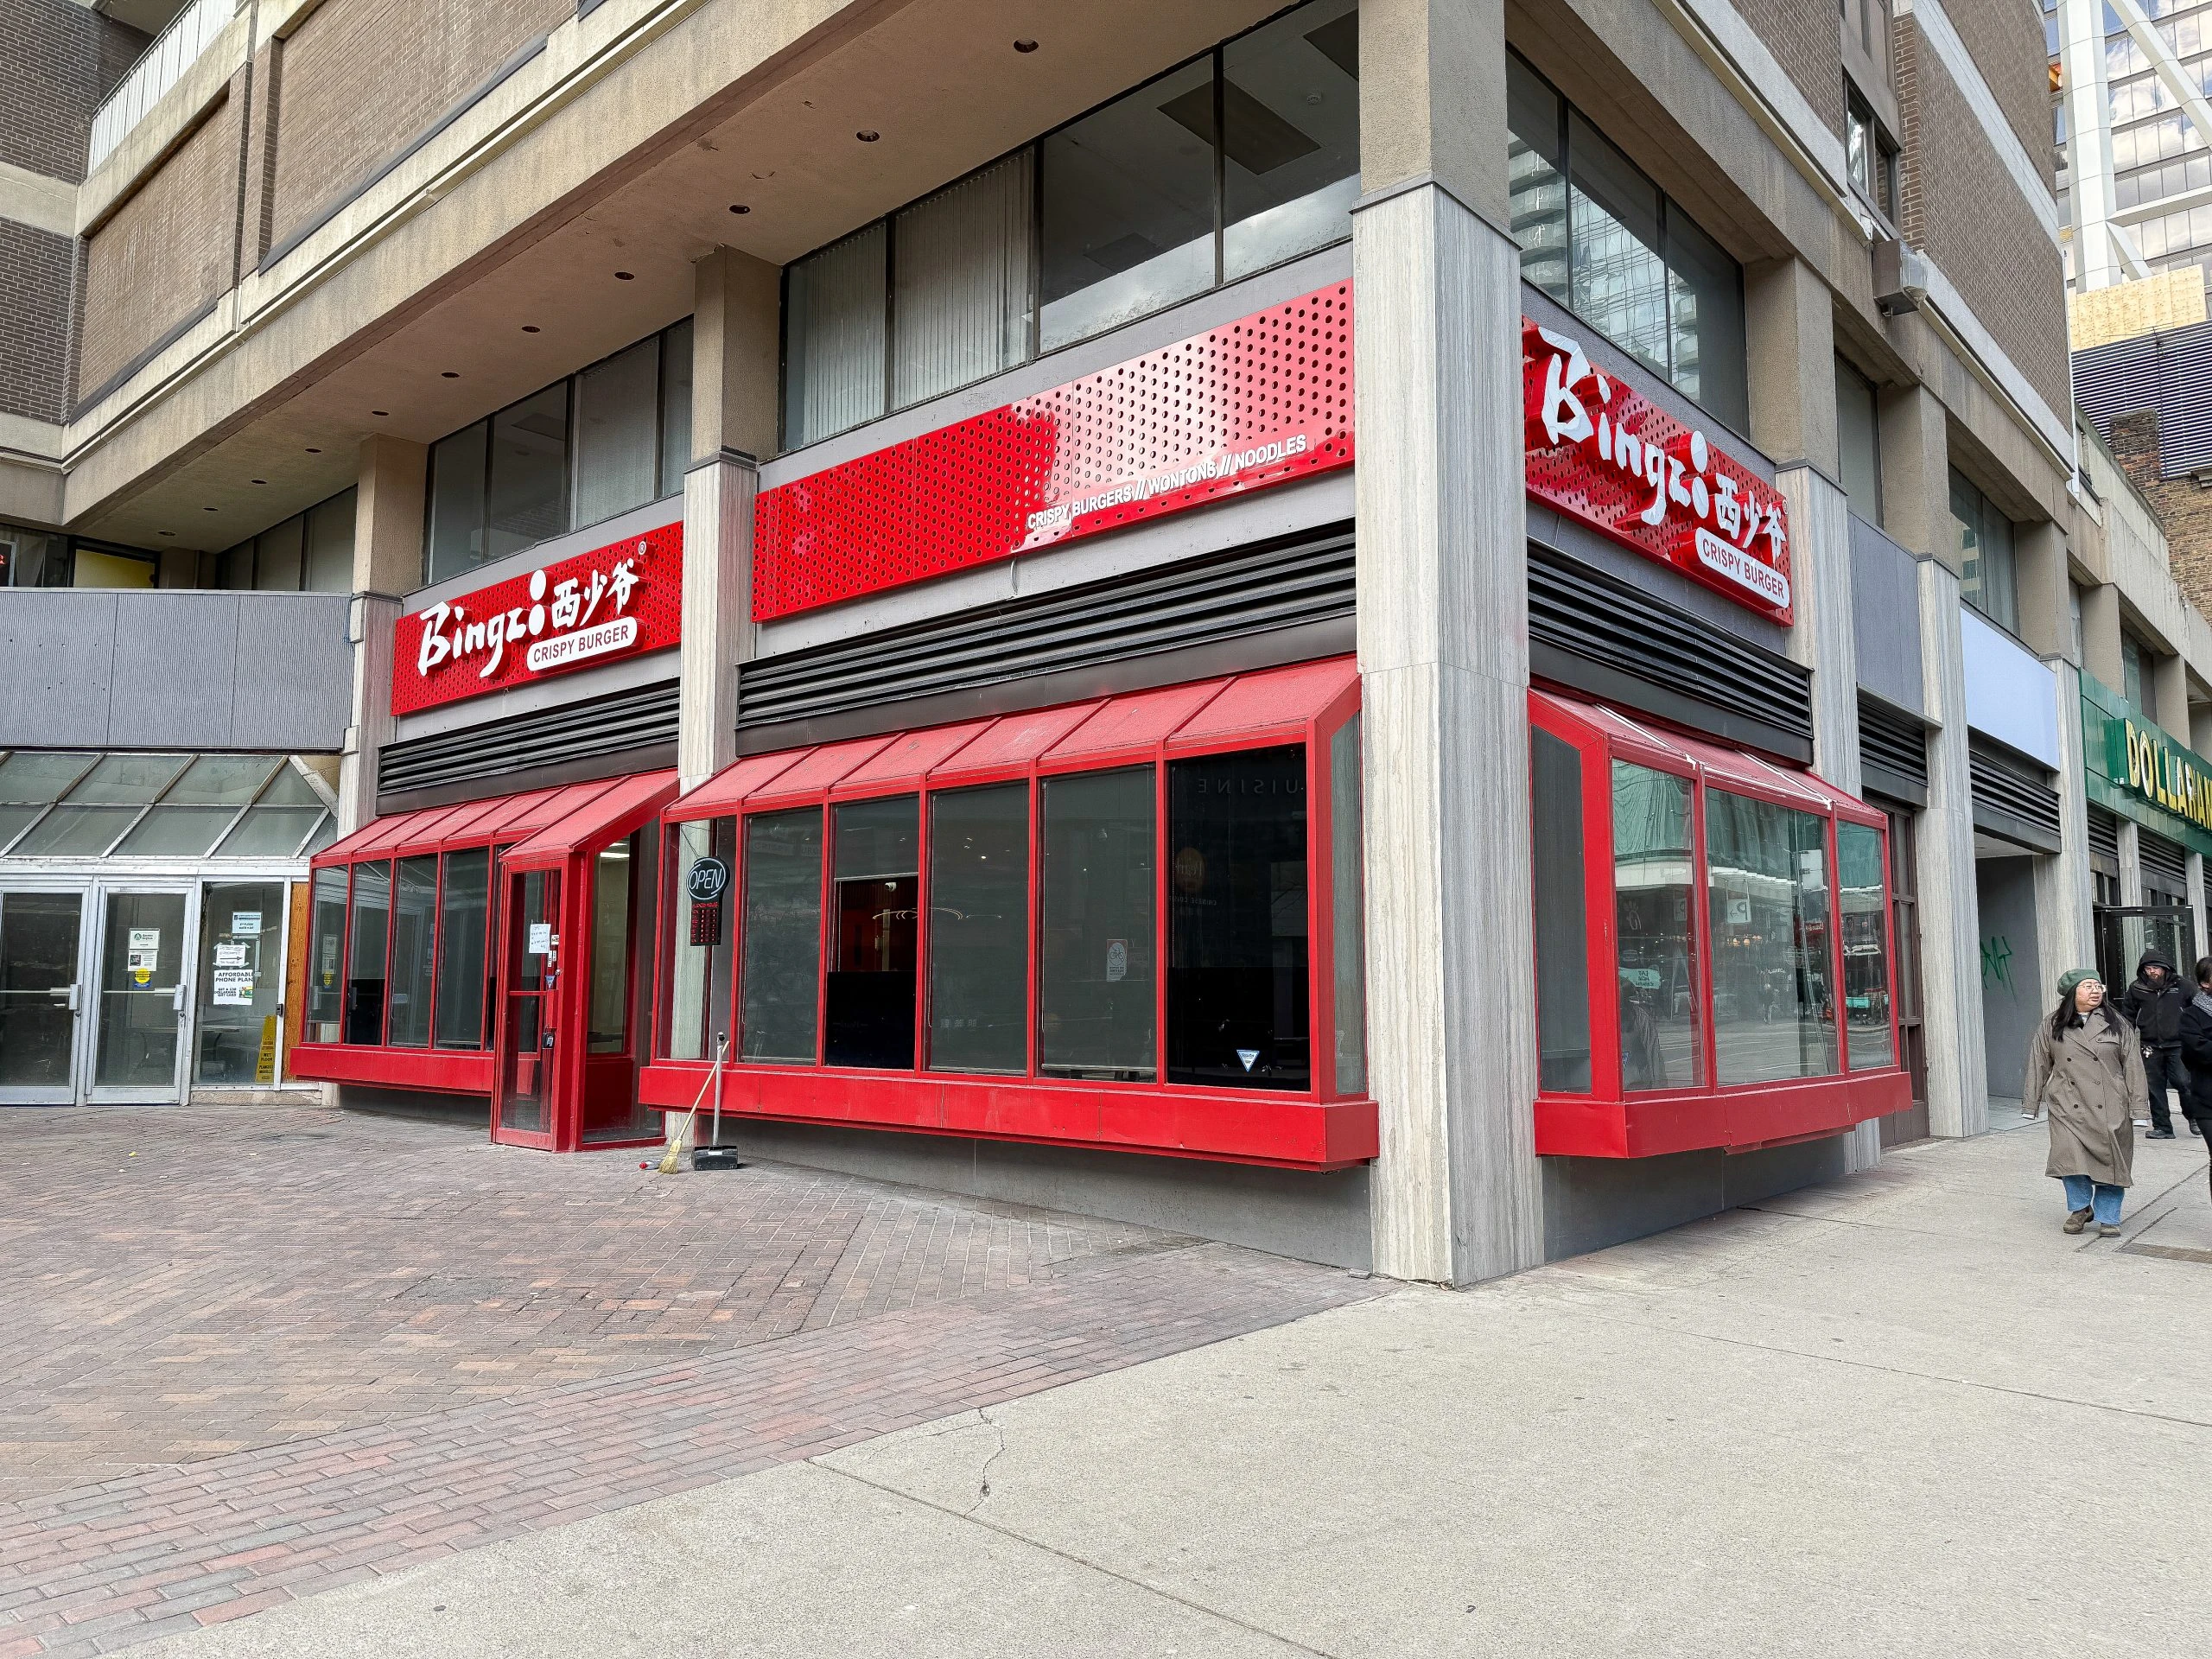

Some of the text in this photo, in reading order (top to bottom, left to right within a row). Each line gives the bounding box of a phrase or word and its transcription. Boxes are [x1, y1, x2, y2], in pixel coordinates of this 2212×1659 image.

[1027, 506, 1071, 530] CRISPY
[1071, 486, 1133, 518] BURGERS
[1147, 460, 1217, 495] WONTONS
[1234, 434, 1307, 470] NOODLES
[1702, 537, 1784, 599] CRISPY BURGER
[533, 625, 628, 663] CRISPY BURGER
[689, 868, 723, 890] OPEN
